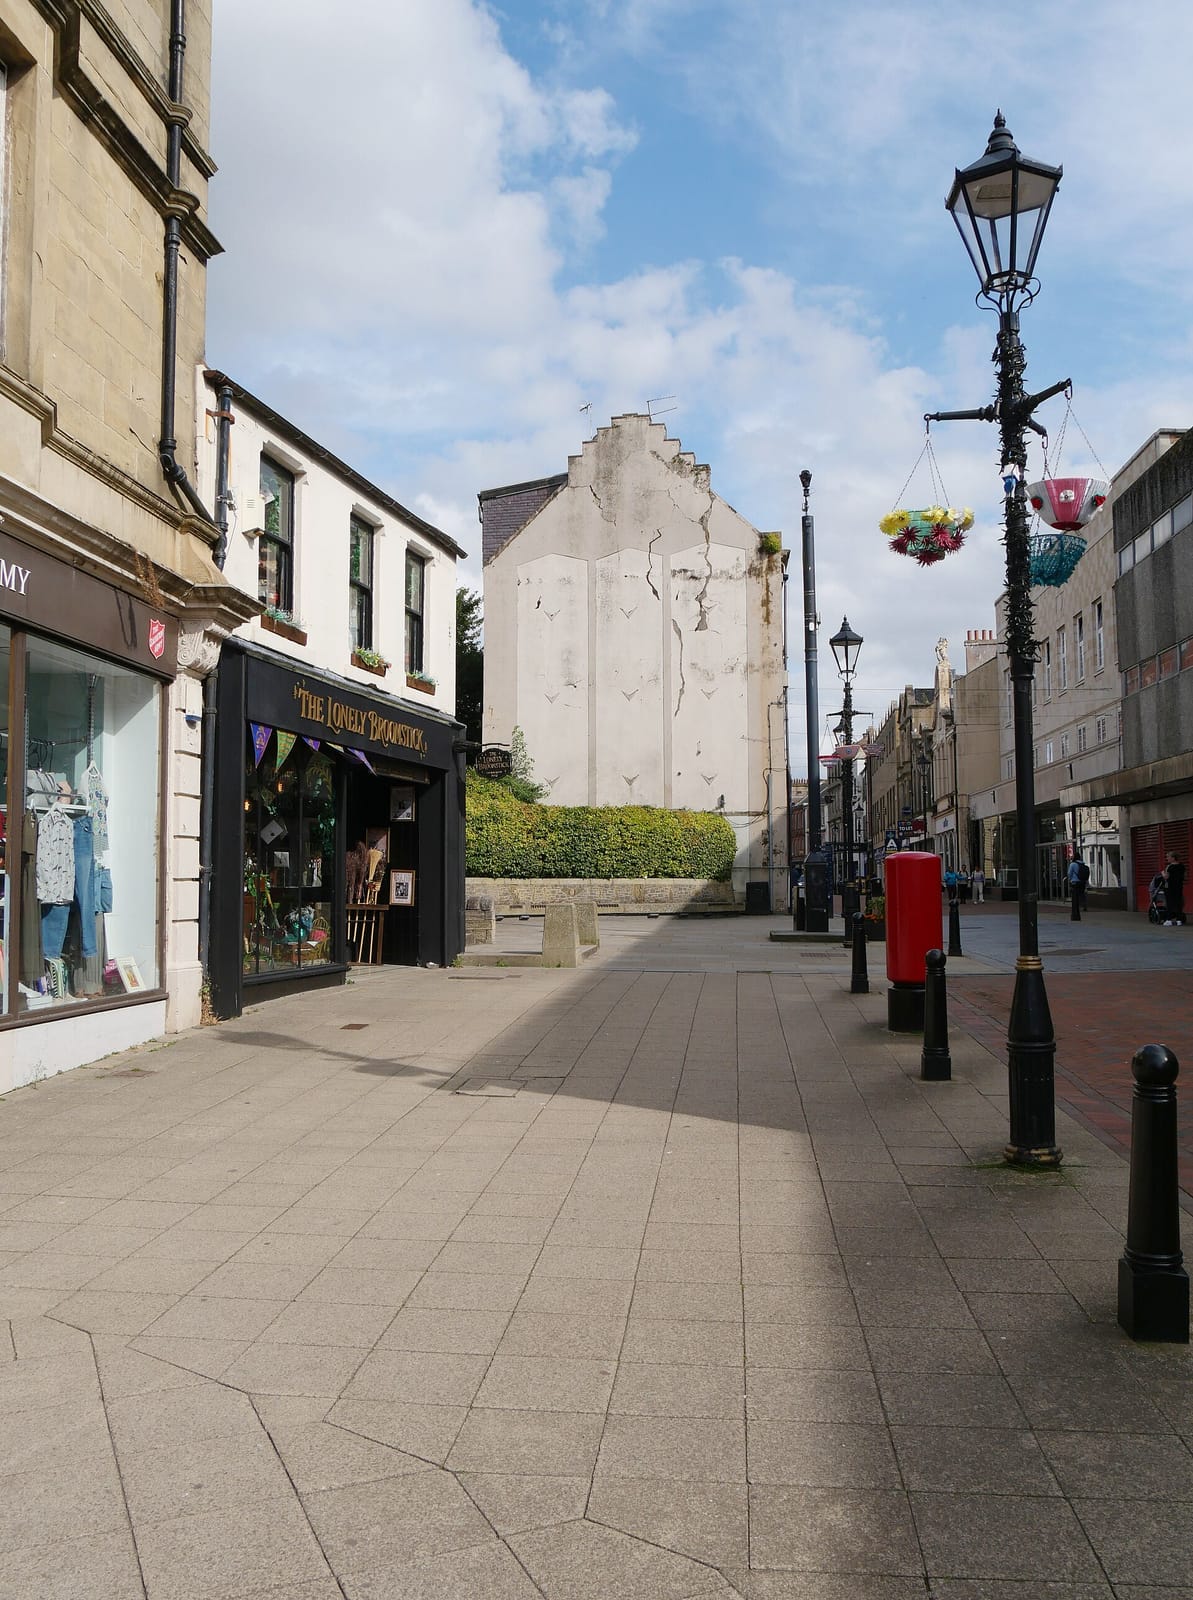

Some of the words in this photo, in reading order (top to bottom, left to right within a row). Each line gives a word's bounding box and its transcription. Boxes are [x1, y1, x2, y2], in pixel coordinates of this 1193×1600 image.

[298, 688, 325, 724] THE
[326, 696, 367, 735] LONELY
[368, 710, 424, 752] BROOMSTICK
